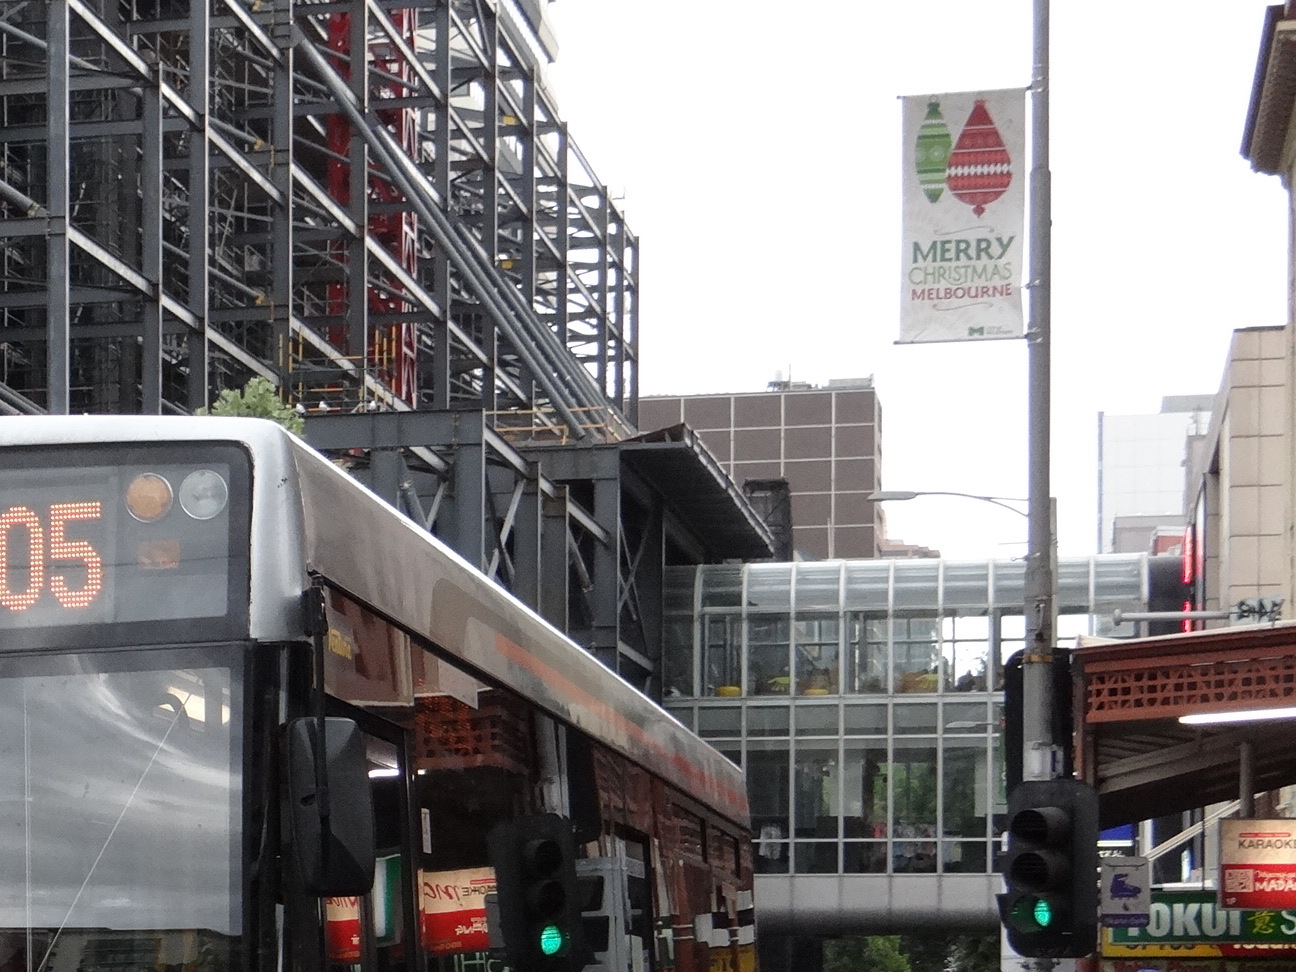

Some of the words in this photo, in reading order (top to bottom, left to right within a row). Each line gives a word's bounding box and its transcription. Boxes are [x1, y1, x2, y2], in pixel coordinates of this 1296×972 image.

[912, 236, 1015, 264] MERRY
[908, 262, 1012, 285] CHRISTMAS
[911, 284, 1012, 301] MELBOURNE
